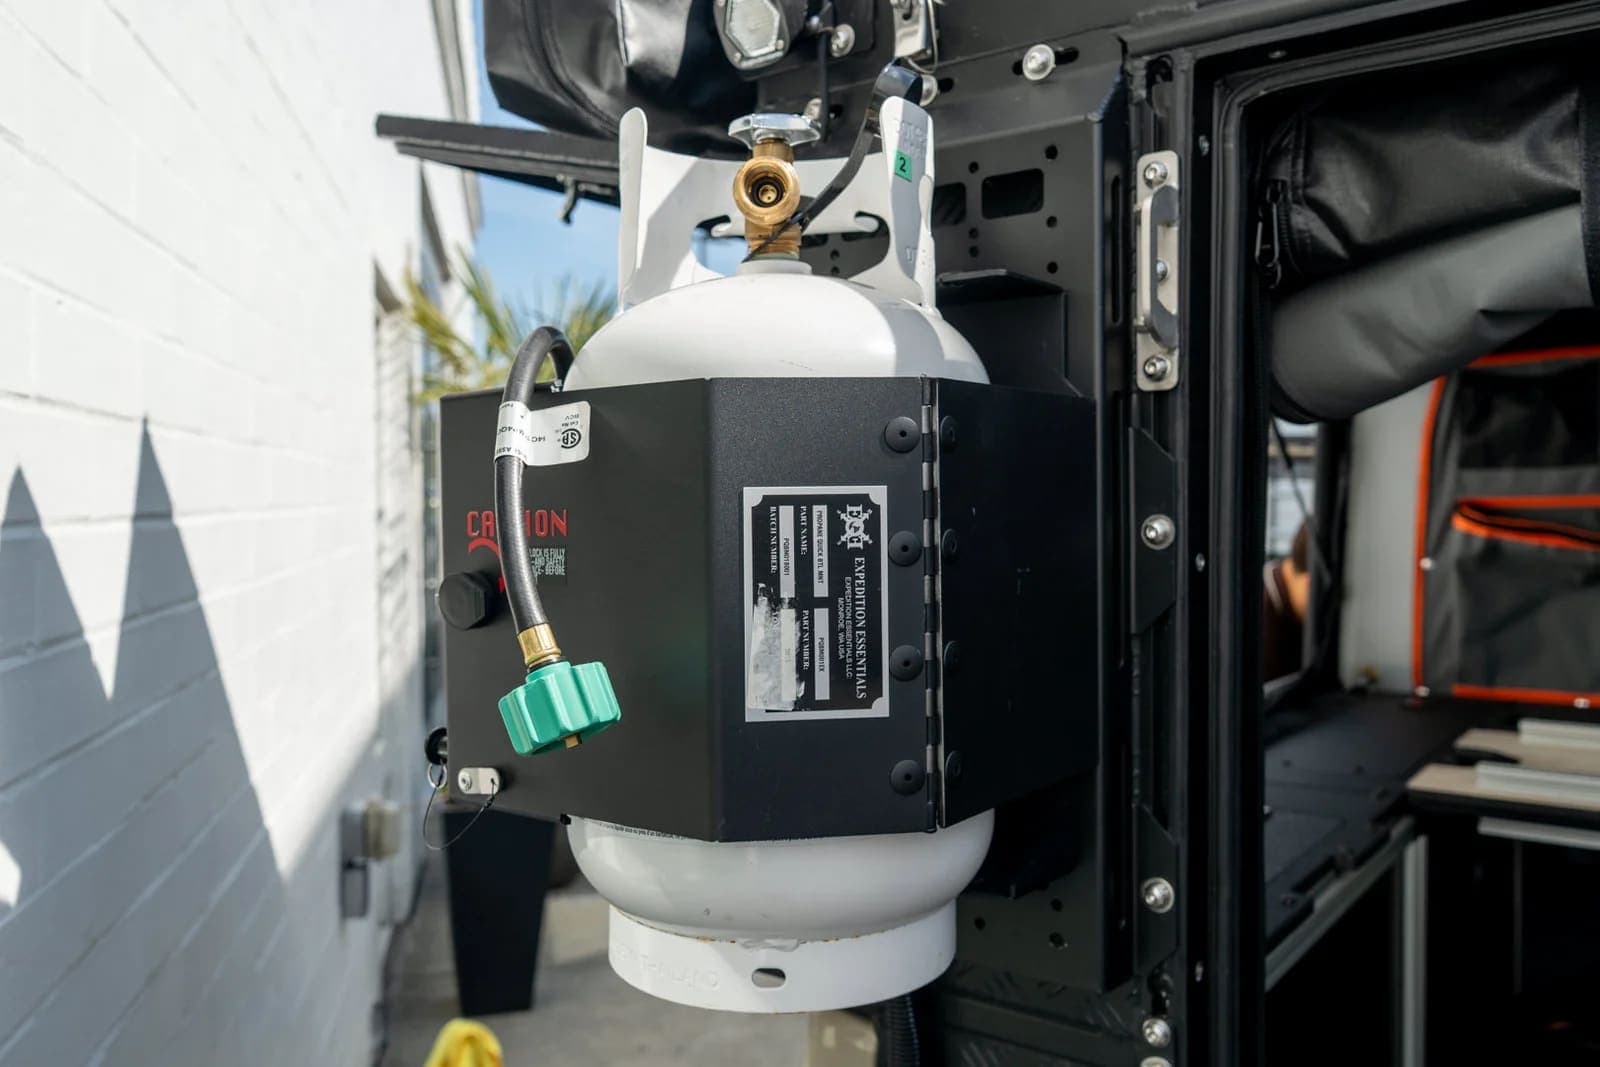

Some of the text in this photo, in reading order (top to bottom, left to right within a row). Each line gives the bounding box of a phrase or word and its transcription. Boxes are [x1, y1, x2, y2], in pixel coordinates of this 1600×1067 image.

[899, 156, 906, 173] 2
[466, 509, 568, 538] CAION
[769, 506, 778, 574] BATCH NUMBER:
[800, 505, 808, 556] PART NAME:
[816, 510, 824, 538] PROPANE
[549, 548, 565, 558] FULLY
[816, 538, 824, 557] QUICK
[545, 565, 565, 575] BEFORE
[844, 576, 853, 620] EXPEDITION
[802, 609, 810, 670] PART NUMBER:
[845, 620, 853, 663] ESSENTIALS
[854, 557, 867, 699] EXPEDITION ESSENTIALS
